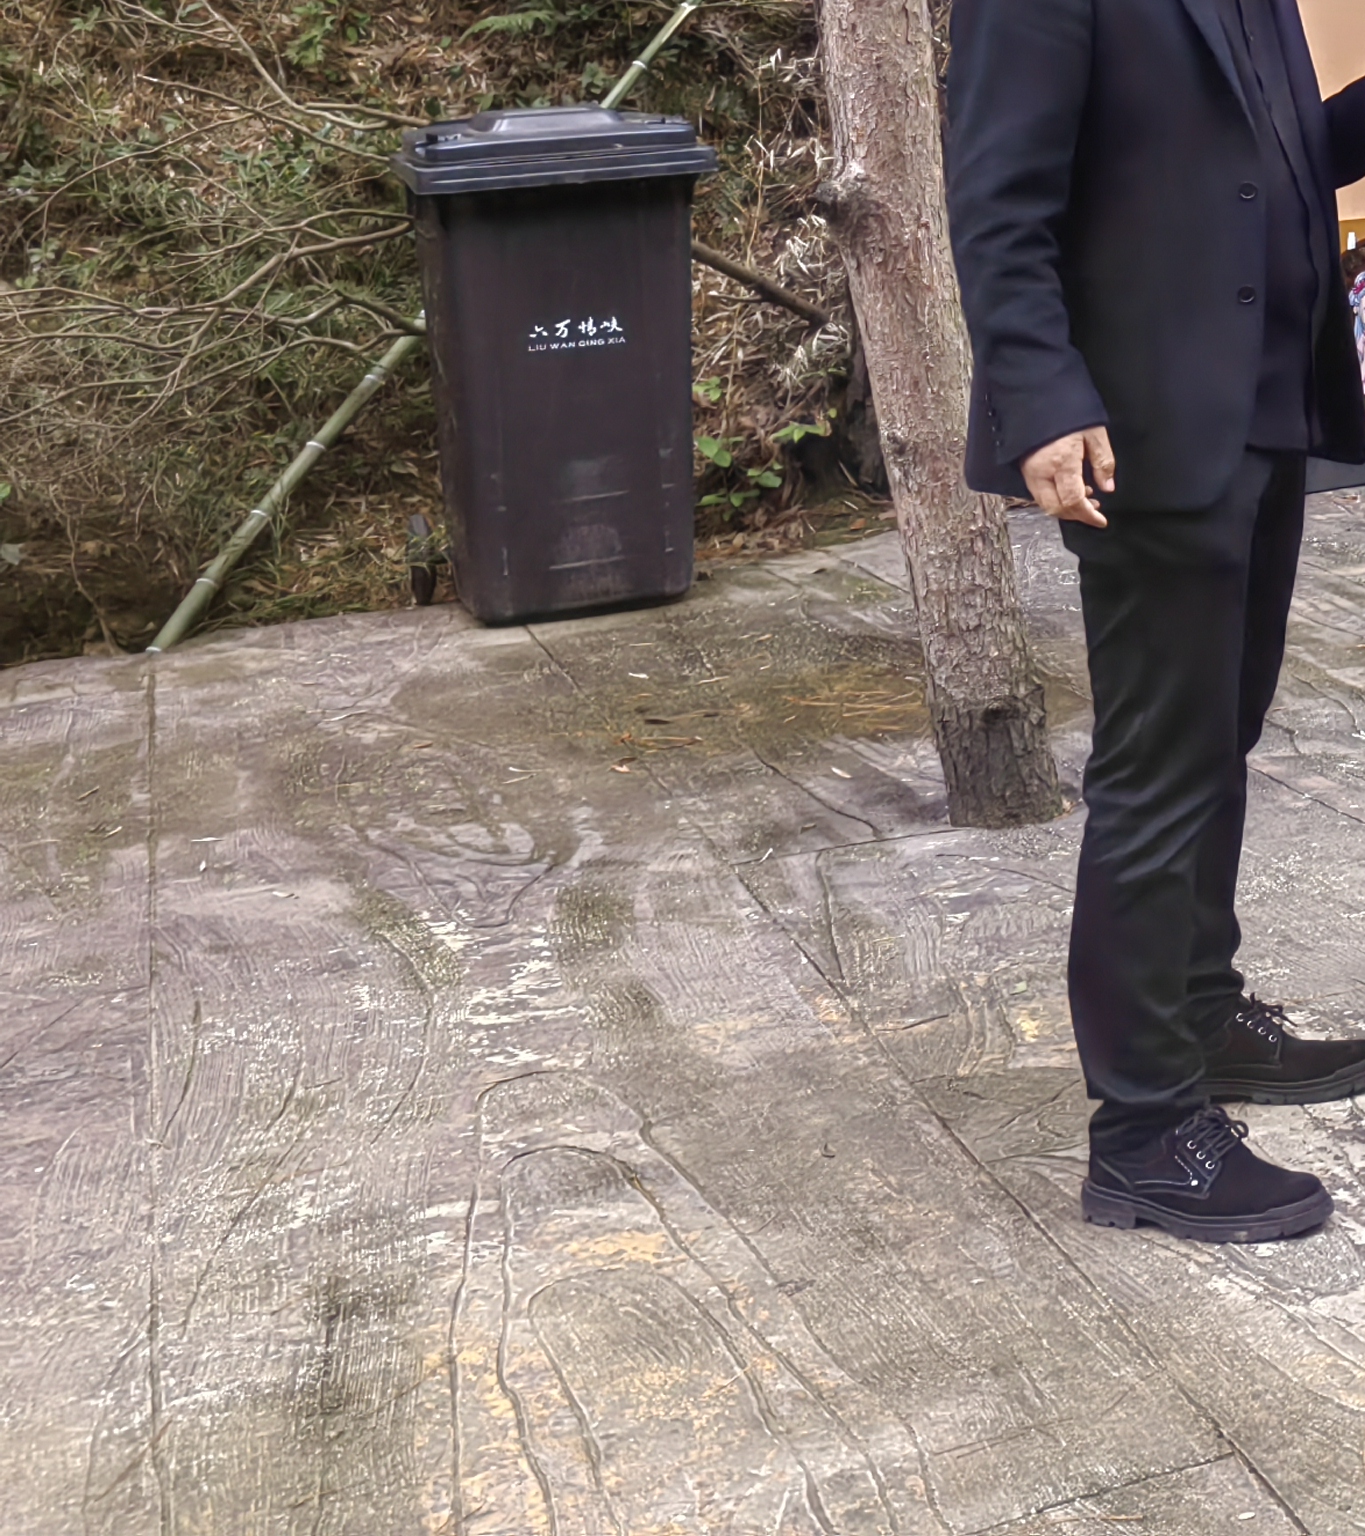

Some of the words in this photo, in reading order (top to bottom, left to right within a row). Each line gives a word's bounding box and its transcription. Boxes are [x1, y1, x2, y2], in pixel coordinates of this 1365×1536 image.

[550, 341, 575, 349] WAN
[578, 338, 605, 346] QING
[607, 336, 626, 344] XIA
